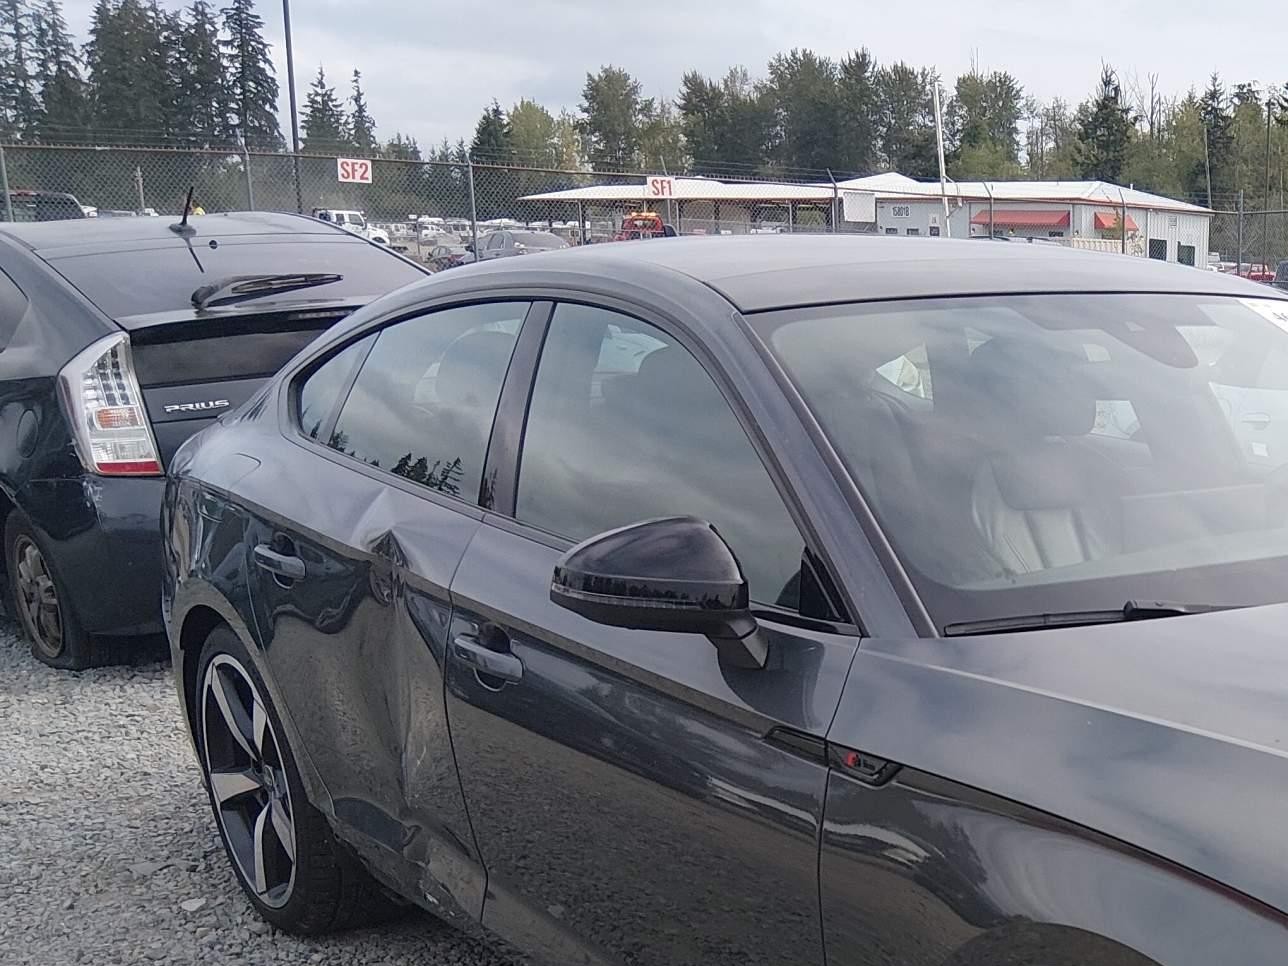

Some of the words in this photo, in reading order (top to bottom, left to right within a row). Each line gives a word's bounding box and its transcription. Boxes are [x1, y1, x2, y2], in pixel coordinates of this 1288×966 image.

[340, 160, 369, 181] SF2
[651, 178, 673, 197] SF1
[163, 399, 230, 413] PRIUS
